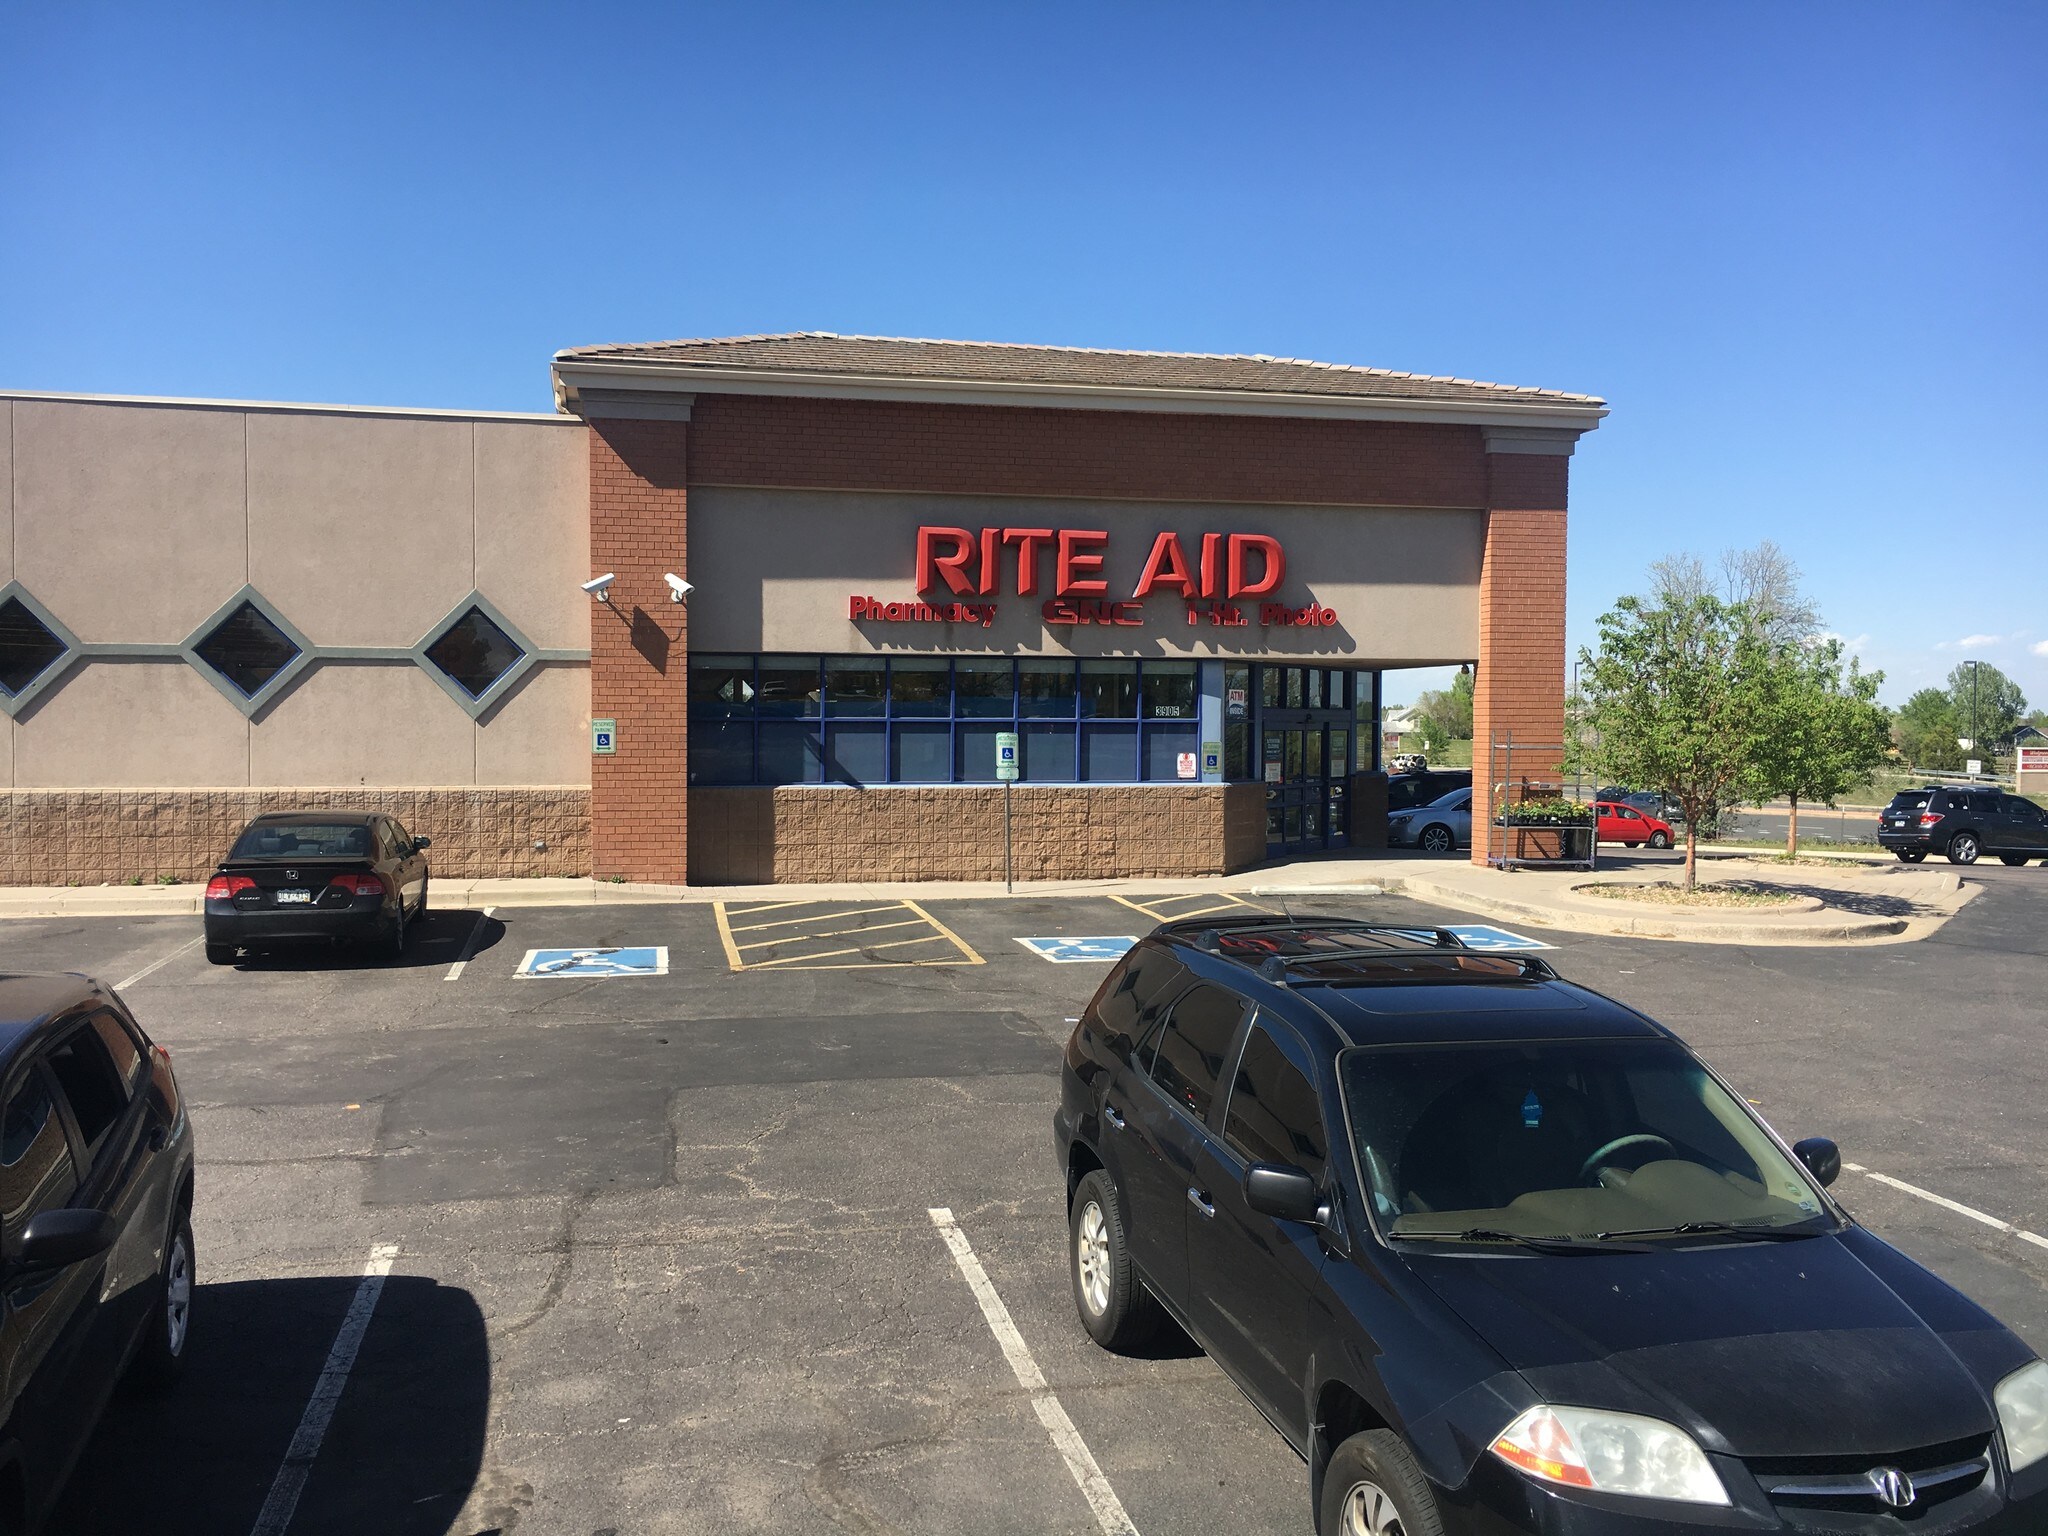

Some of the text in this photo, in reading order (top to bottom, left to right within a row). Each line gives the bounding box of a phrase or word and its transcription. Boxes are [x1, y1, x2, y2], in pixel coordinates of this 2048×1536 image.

[915, 525, 1287, 599] RITE AID
[848, 595, 998, 628] Pharmacy
[1041, 601, 1144, 626] GNC
[1258, 601, 1338, 627] Photo
[1230, 690, 1244, 701] ATM
[1155, 706, 1180, 717] 3905
[1229, 707, 1244, 715] INSIDE
